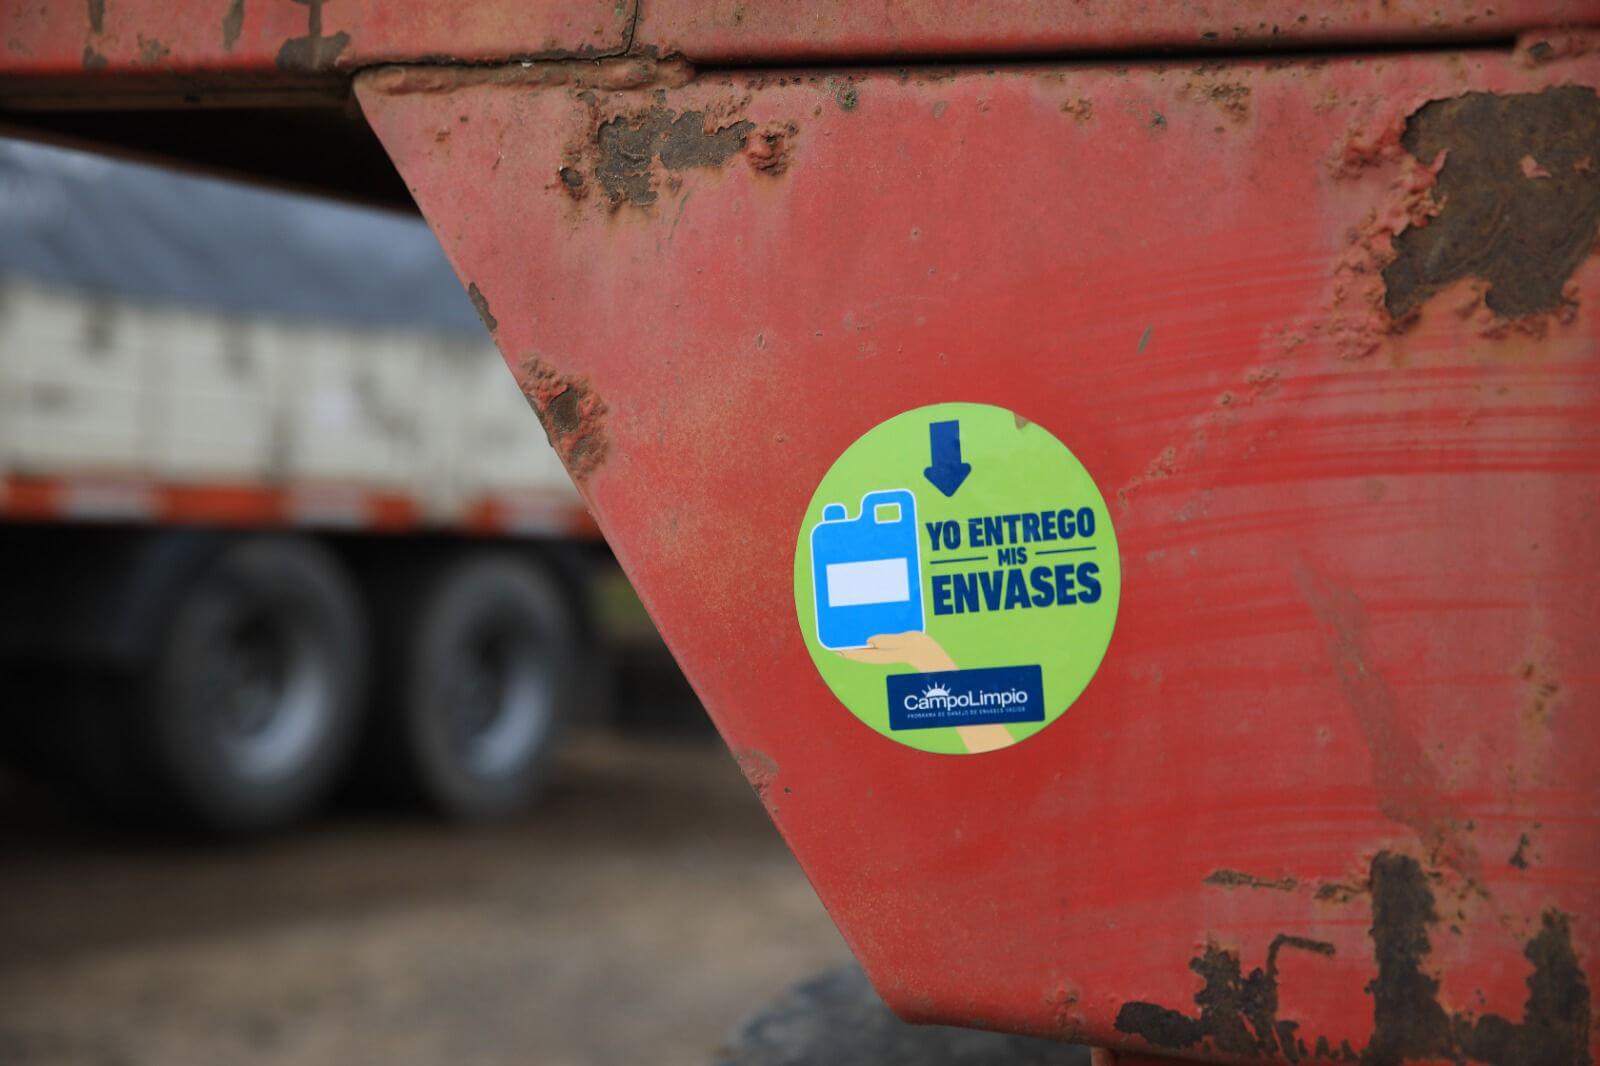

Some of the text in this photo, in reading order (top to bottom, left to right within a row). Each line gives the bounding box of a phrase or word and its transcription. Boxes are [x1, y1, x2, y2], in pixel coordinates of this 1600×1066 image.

[925, 506, 1096, 551] YO ENTREGO
[997, 547, 1028, 566] MIS
[931, 562, 1102, 616] ENVASES
[904, 688, 1028, 711] CampoLimpio
